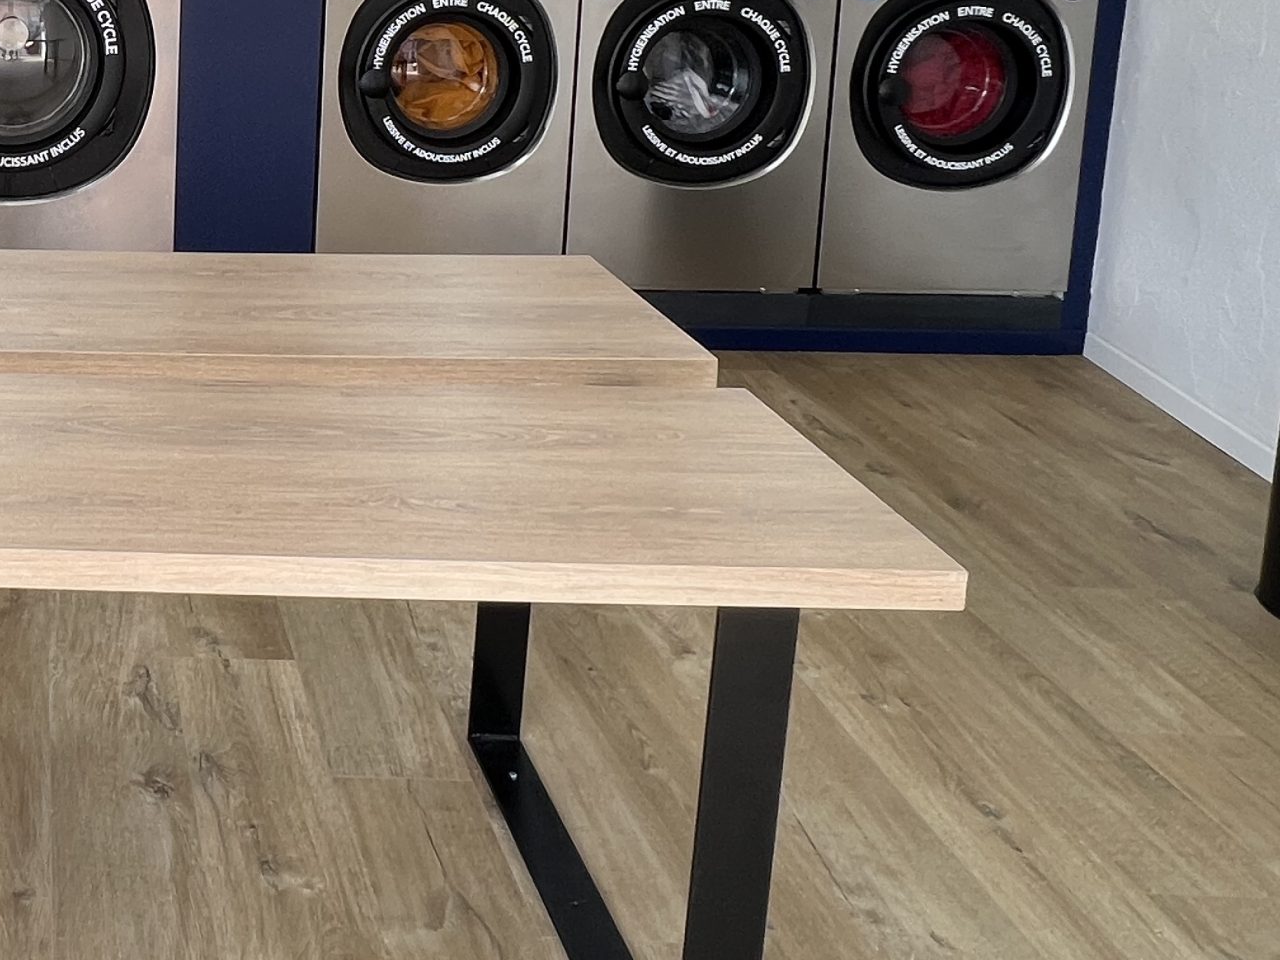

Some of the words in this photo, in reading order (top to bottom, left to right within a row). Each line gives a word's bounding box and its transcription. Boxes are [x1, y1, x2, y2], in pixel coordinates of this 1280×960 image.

[97, 9, 118, 55] CYCLE
[373, 3, 426, 70] HYGIENISATION
[477, 1, 519, 32] CHAQUE
[514, 30, 533, 63] CYCLE
[627, 6, 686, 71] HYGIENISATION
[693, 0, 731, 11] ENTRE
[740, 7, 780, 41] CHAQUE
[774, 39, 791, 73] CYCLE
[886, 11, 950, 74] HYGIENISATION
[957, 6, 995, 17] ENTRE
[1002, 12, 1042, 46] CHAQUE
[1036, 44, 1052, 78] CYCLE
[50, 127, 86, 158] INCLUS
[383, 116, 405, 146] LESSIVE
[403, 141, 413, 152] ET
[413, 148, 472, 163] ADOUCISSANT
[473, 137, 501, 158] INCLUS
[642, 124, 666, 153] LESSIVE
[664, 146, 677, 158] ET
[675, 152, 736, 165] ADOUCISSANT
[735, 133, 763, 157] INCLUS
[894, 124, 917, 155] LESSIVE
[914, 150, 927, 160] ET
[924, 155, 984, 170] ADOUCISSANT
[985, 143, 1014, 164] INCLUS
